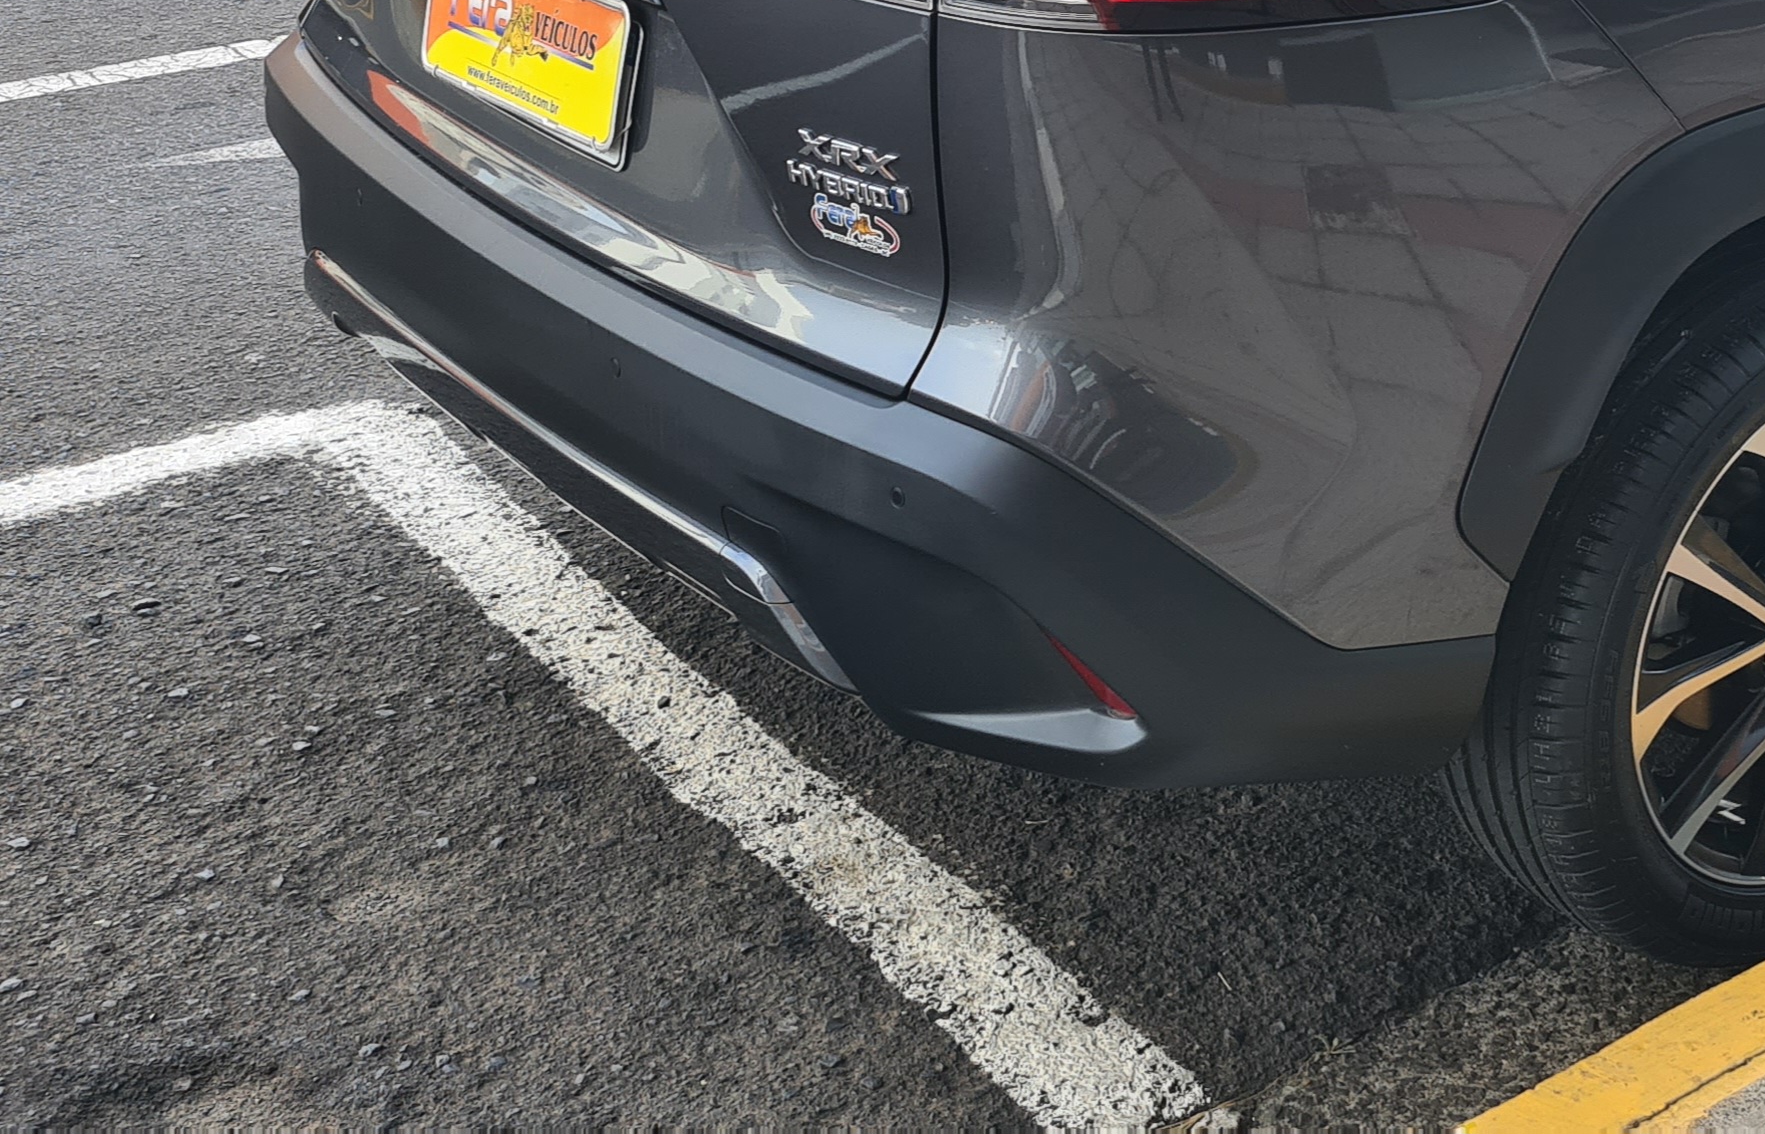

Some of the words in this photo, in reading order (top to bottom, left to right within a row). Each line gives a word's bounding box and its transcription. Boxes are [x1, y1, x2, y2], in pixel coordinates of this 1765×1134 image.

[534, 9, 598, 62] VEÍCULOS
[466, 64, 560, 116] www.feraveiculos.com.br
[798, 127, 901, 182] XRX
[786, 159, 893, 210] HYBRID
